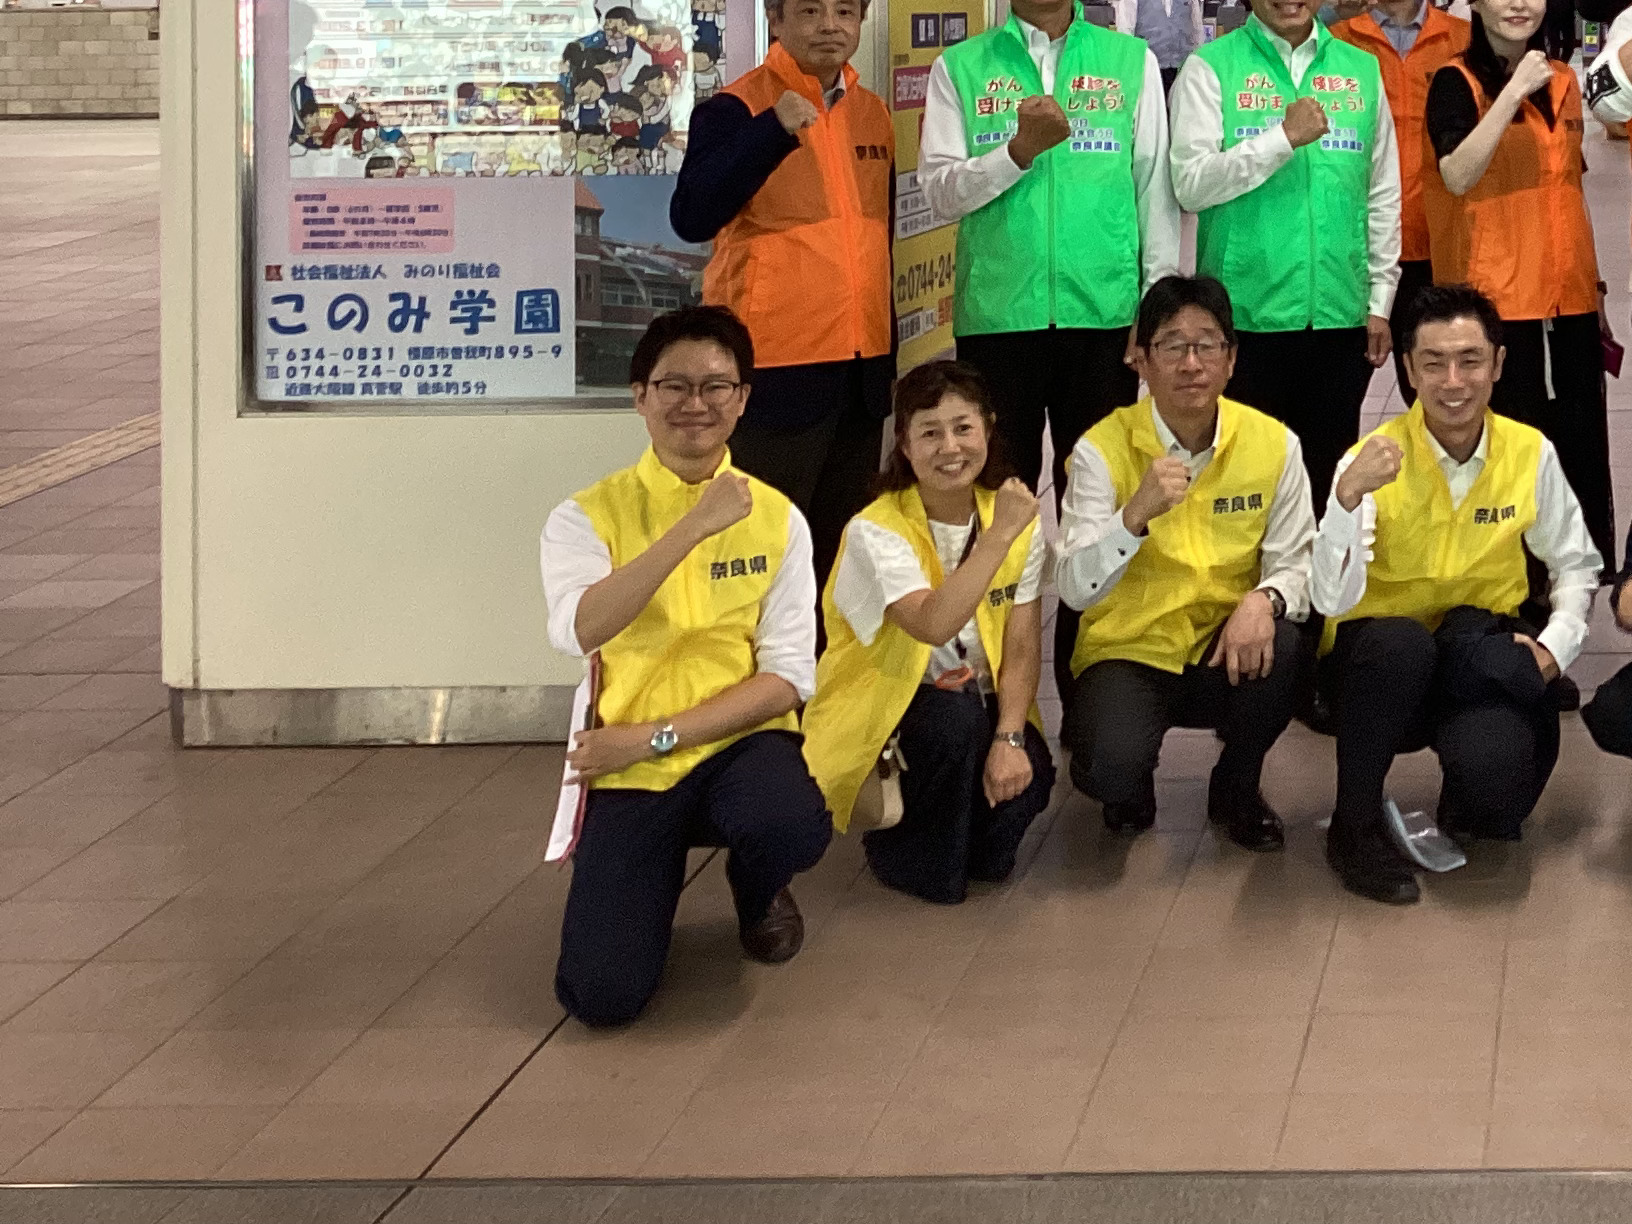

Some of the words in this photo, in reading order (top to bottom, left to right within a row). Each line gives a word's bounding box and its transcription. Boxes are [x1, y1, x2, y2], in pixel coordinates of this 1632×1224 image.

[987, 77, 1022, 91] がん
[1072, 76, 1120, 93] 検診を
[1246, 75, 1275, 89] がん
[1313, 76, 1359, 92] 検診を
[1238, 92, 1283, 110] 受けま
[1319, 94, 1365, 112] ょう!
[291, 265, 387, 280] 社会福祉法人
[404, 264, 501, 279] みのり福祉会
[267, 289, 561, 335] このみ学園
[1213, 493, 1262, 514] 奈良県
[1474, 505, 1515, 524] 奈良県
[711, 555, 767, 580] 奈良県
